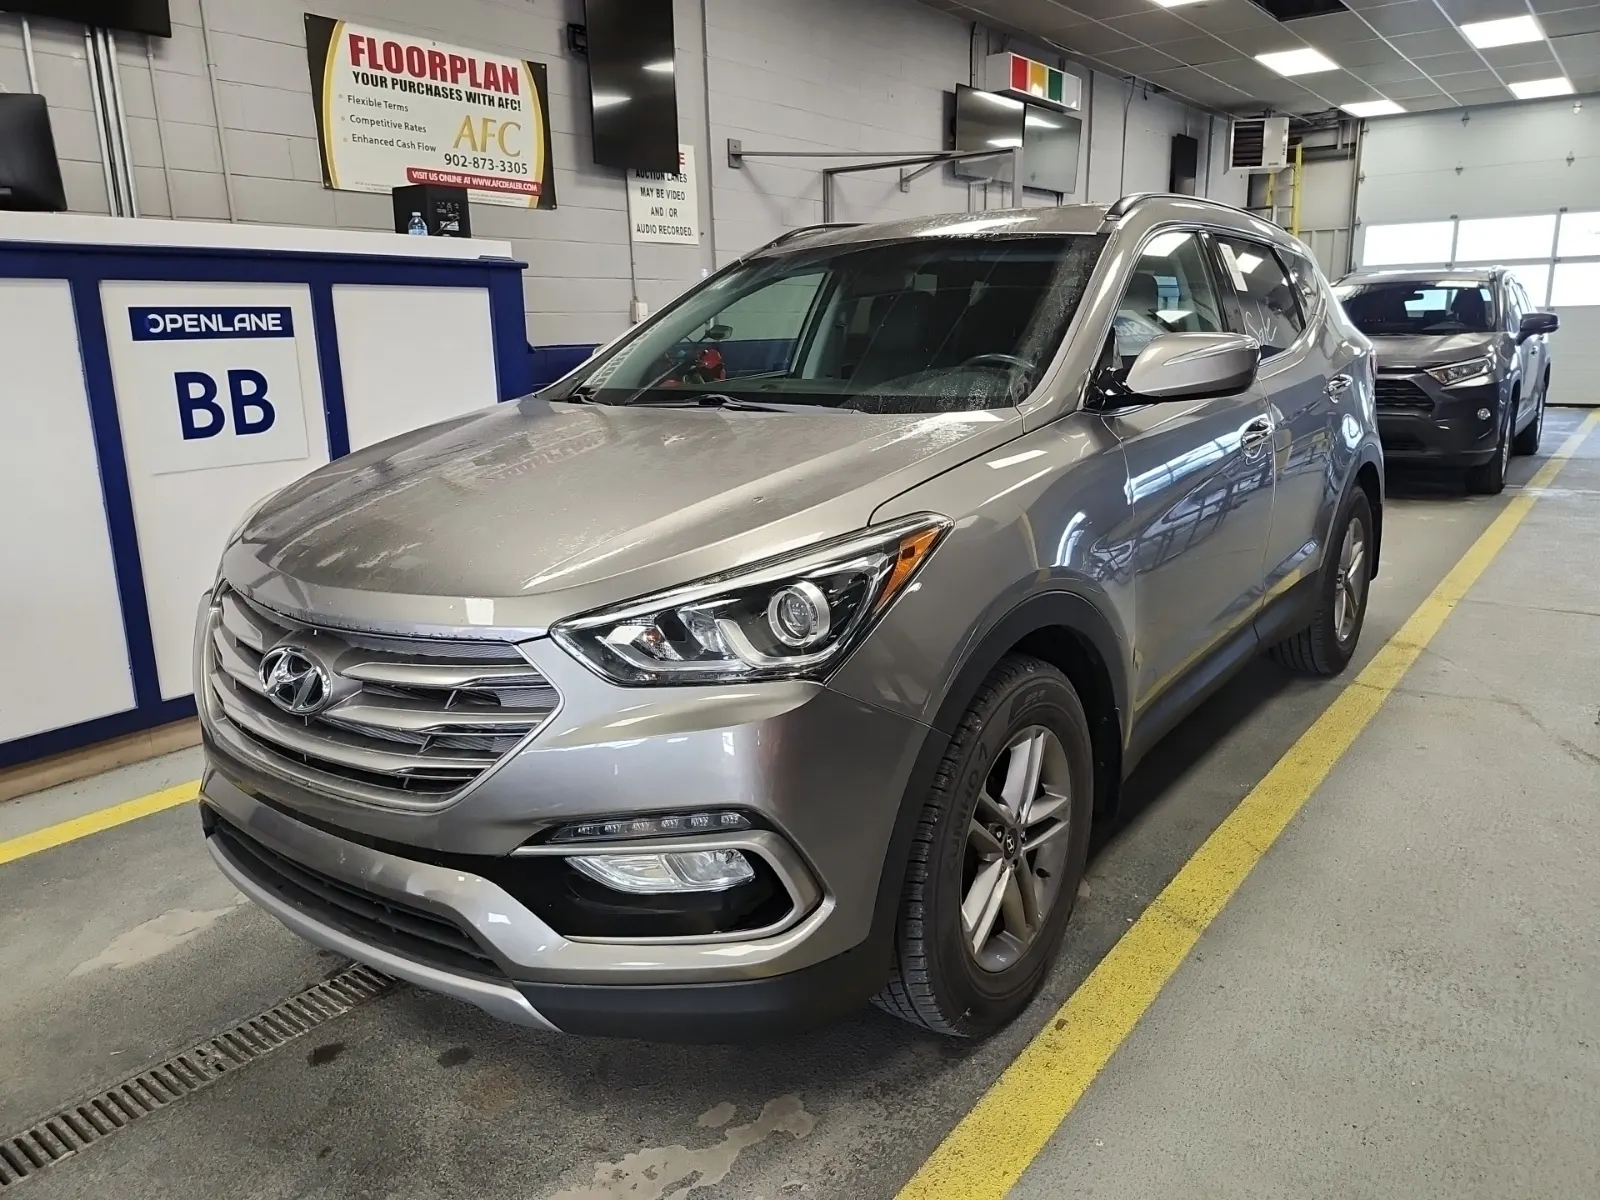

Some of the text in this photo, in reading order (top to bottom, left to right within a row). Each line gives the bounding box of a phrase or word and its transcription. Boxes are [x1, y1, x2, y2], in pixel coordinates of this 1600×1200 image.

[348, 33, 520, 96] FLOORPLAN
[352, 71, 521, 112] YOUR PURCHASES WITH AFC!
[347, 95, 409, 112] Flexible Terms
[349, 114, 427, 133] Competitive Rates
[352, 133, 437, 152] Enhanced Cash Flow
[452, 115, 521, 157] AFC
[444, 153, 528, 174] 902-873-3305
[411, 170, 538, 192] VISIT US ONLINE AT WWW.AFCDEALER.COM
[640, 187, 686, 201] MAY BE VIDEO
[651, 207, 664, 217] AND
[668, 208, 678, 218] OR
[636, 223, 694, 237] AUDIO RECORDED.
[147, 313, 283, 333] OPENLANE
[174, 369, 276, 440] BB
